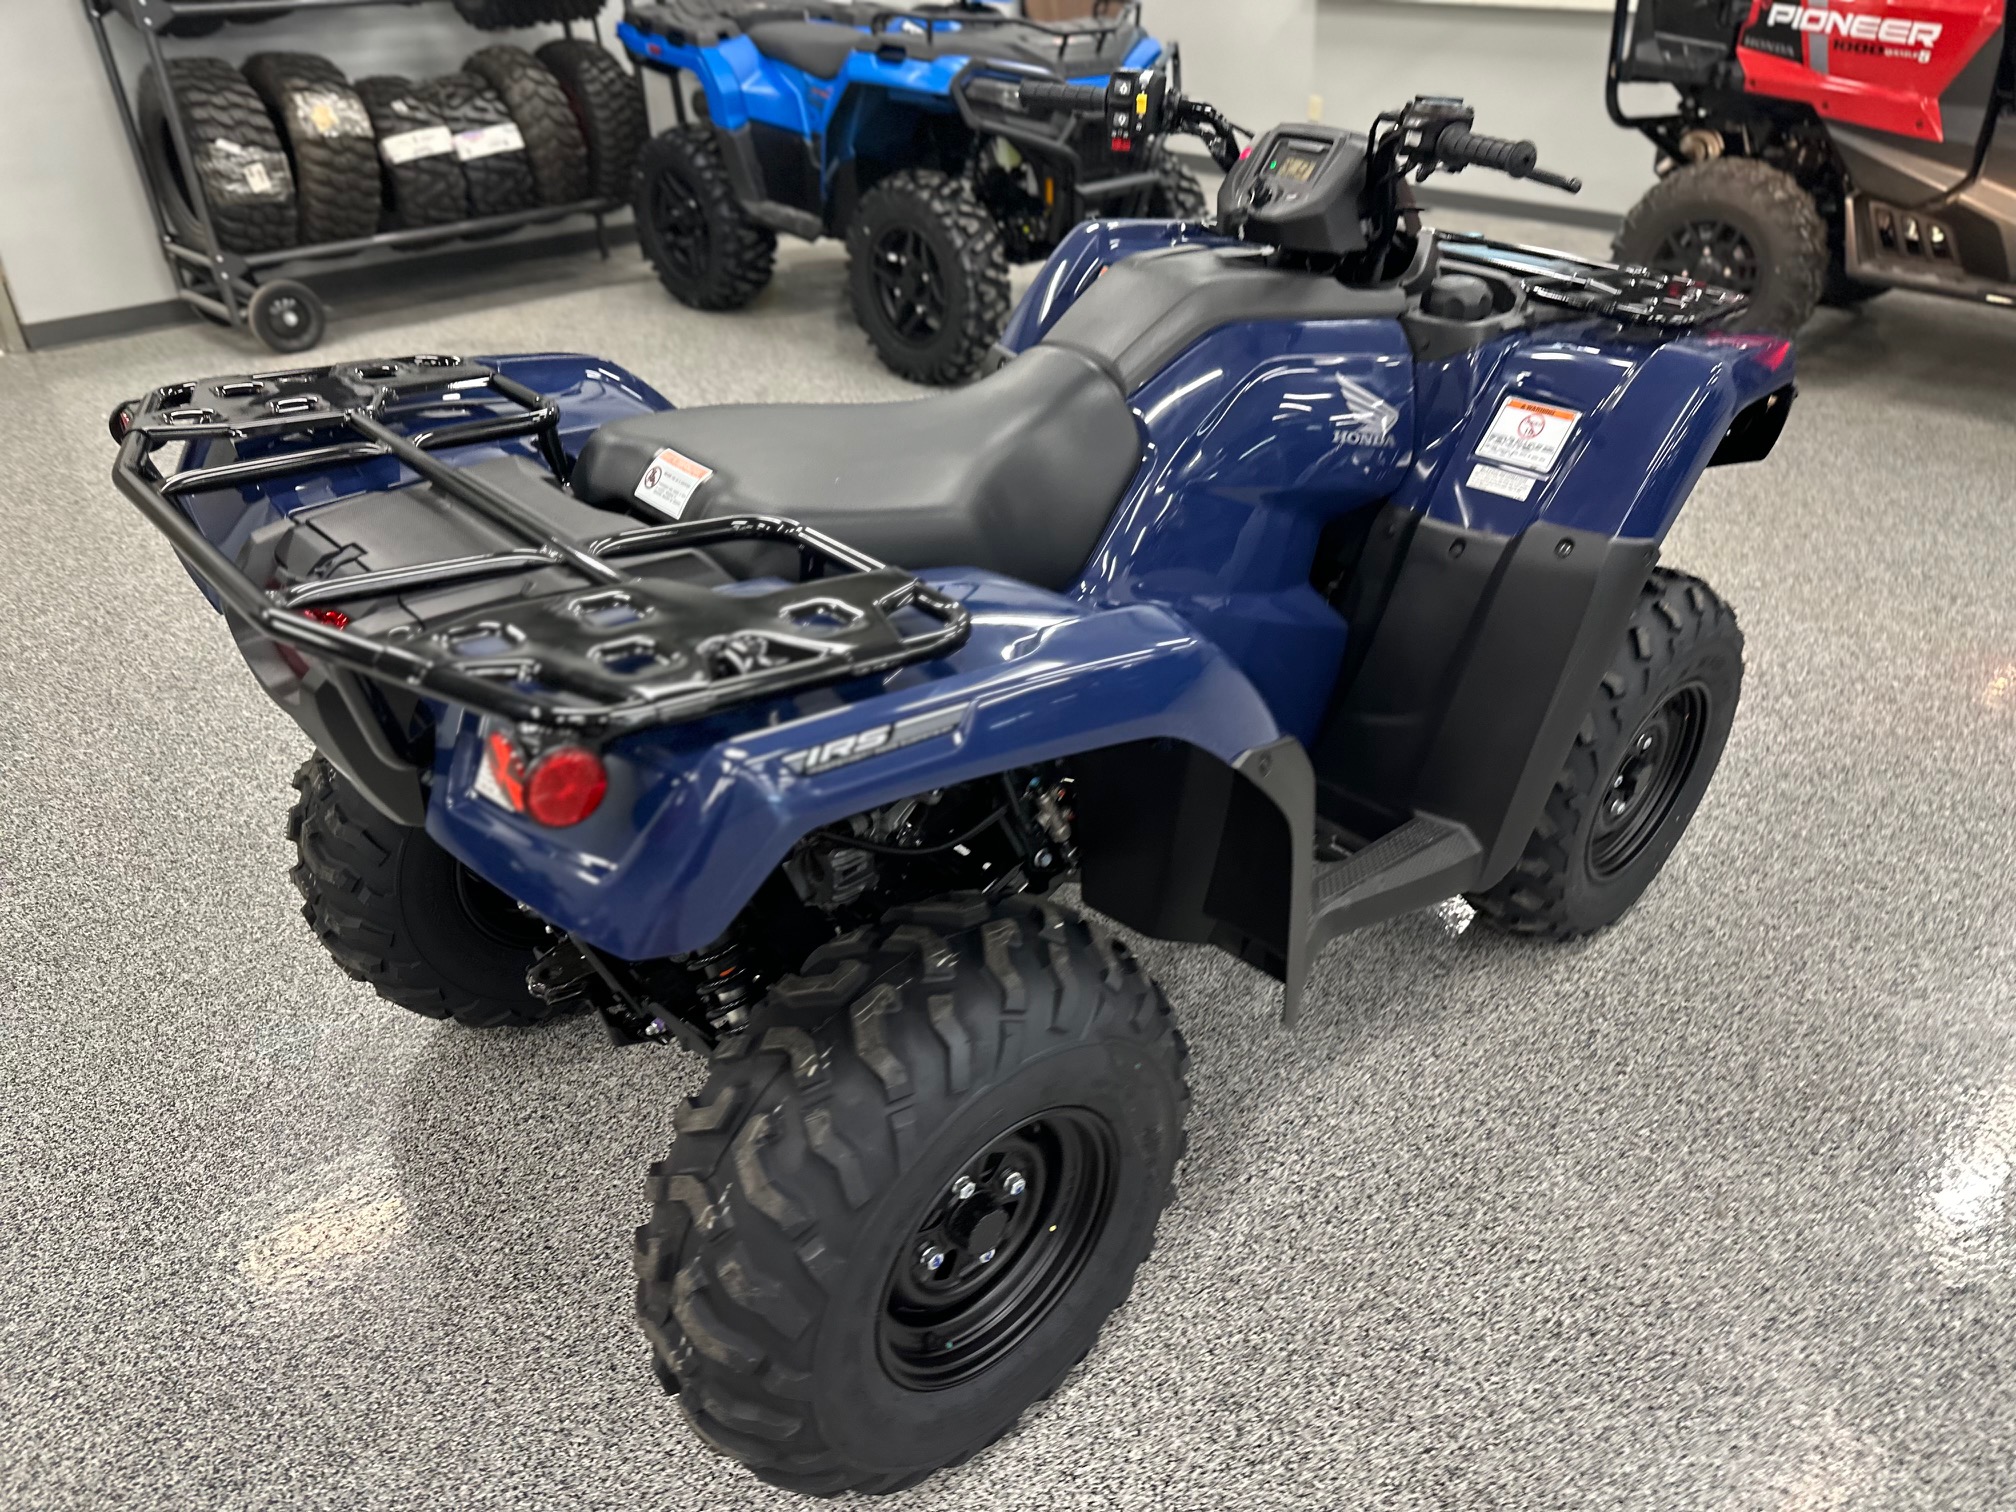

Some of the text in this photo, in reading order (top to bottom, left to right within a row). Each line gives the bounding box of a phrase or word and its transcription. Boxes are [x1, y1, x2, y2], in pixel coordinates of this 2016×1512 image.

[1767, 4, 1942, 47] PIONEER
[1332, 430, 1397, 448] HONDA
[806, 724, 892, 767] IRS
